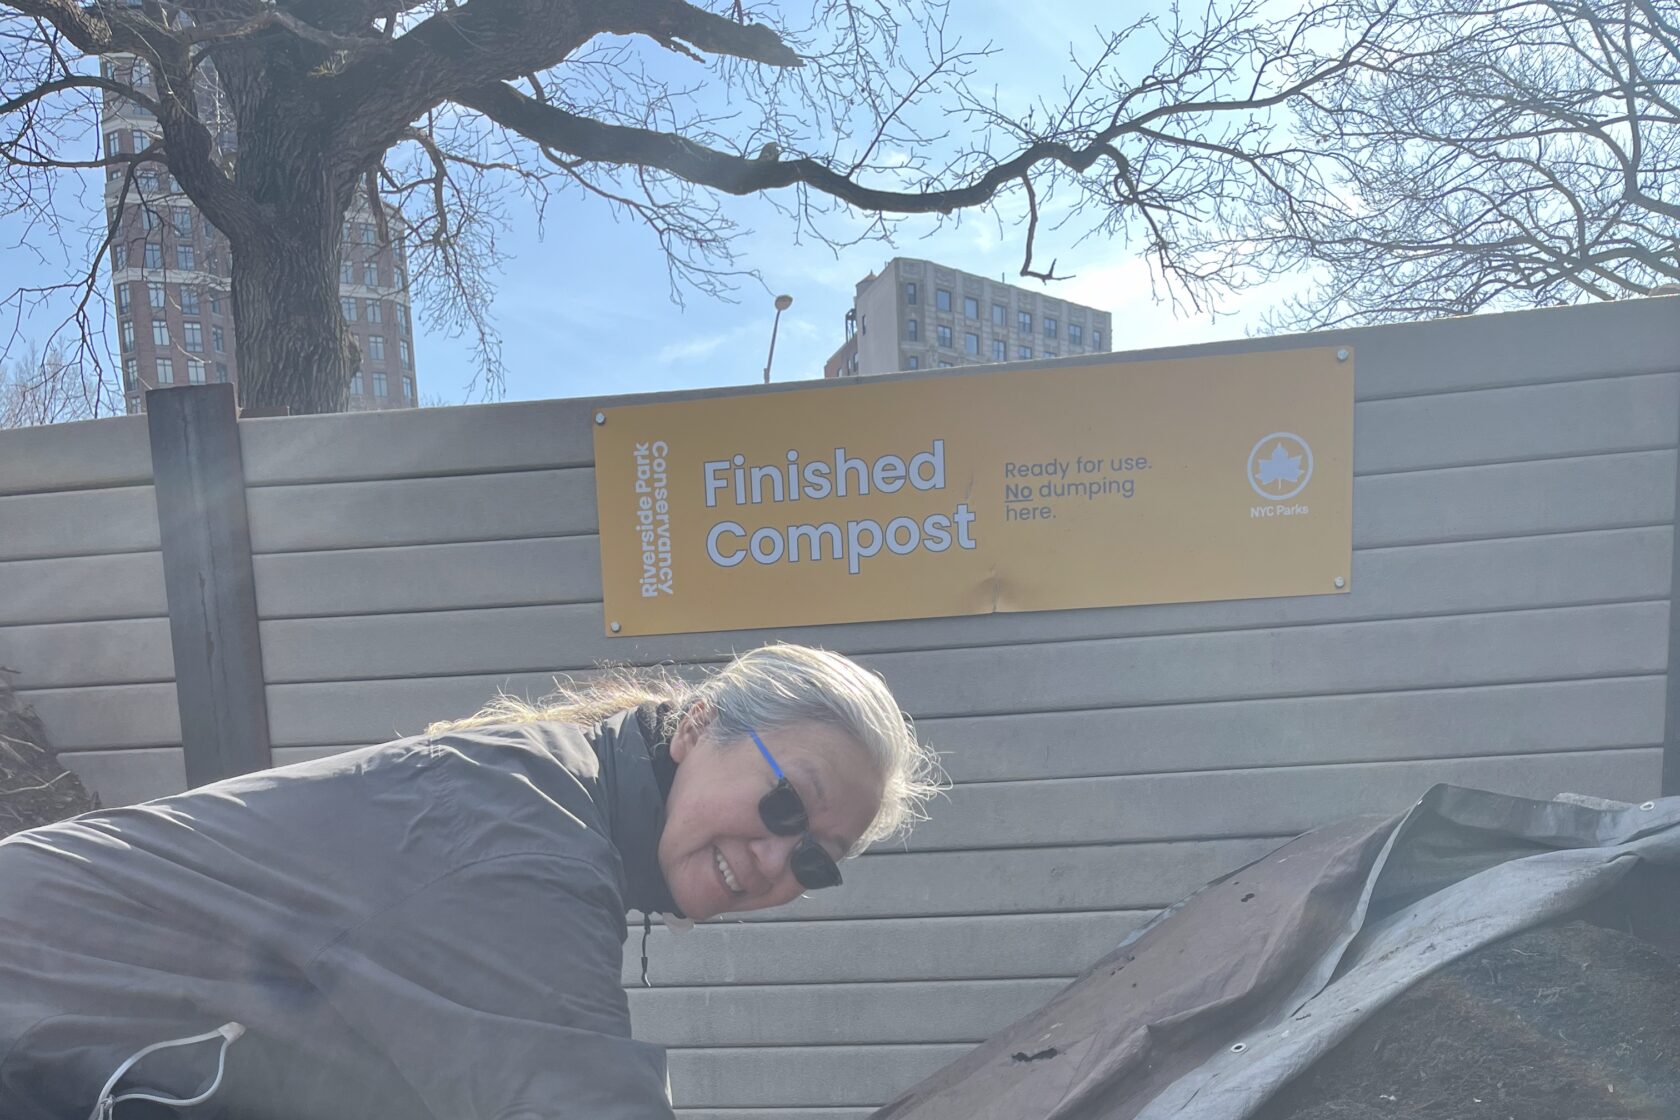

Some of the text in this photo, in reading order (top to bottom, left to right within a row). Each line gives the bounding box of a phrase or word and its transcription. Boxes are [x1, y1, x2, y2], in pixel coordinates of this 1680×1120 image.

[703, 439, 946, 507] Finished
[1005, 456, 1153, 479] Ready for use.
[1005, 477, 1134, 502] No dumping
[633, 442, 658, 597] Riverside Park
[651, 440, 674, 594] Conservancy
[1005, 505, 1056, 522] here.
[1250, 504, 1308, 518] NYC Parks
[706, 504, 977, 575] Compost
